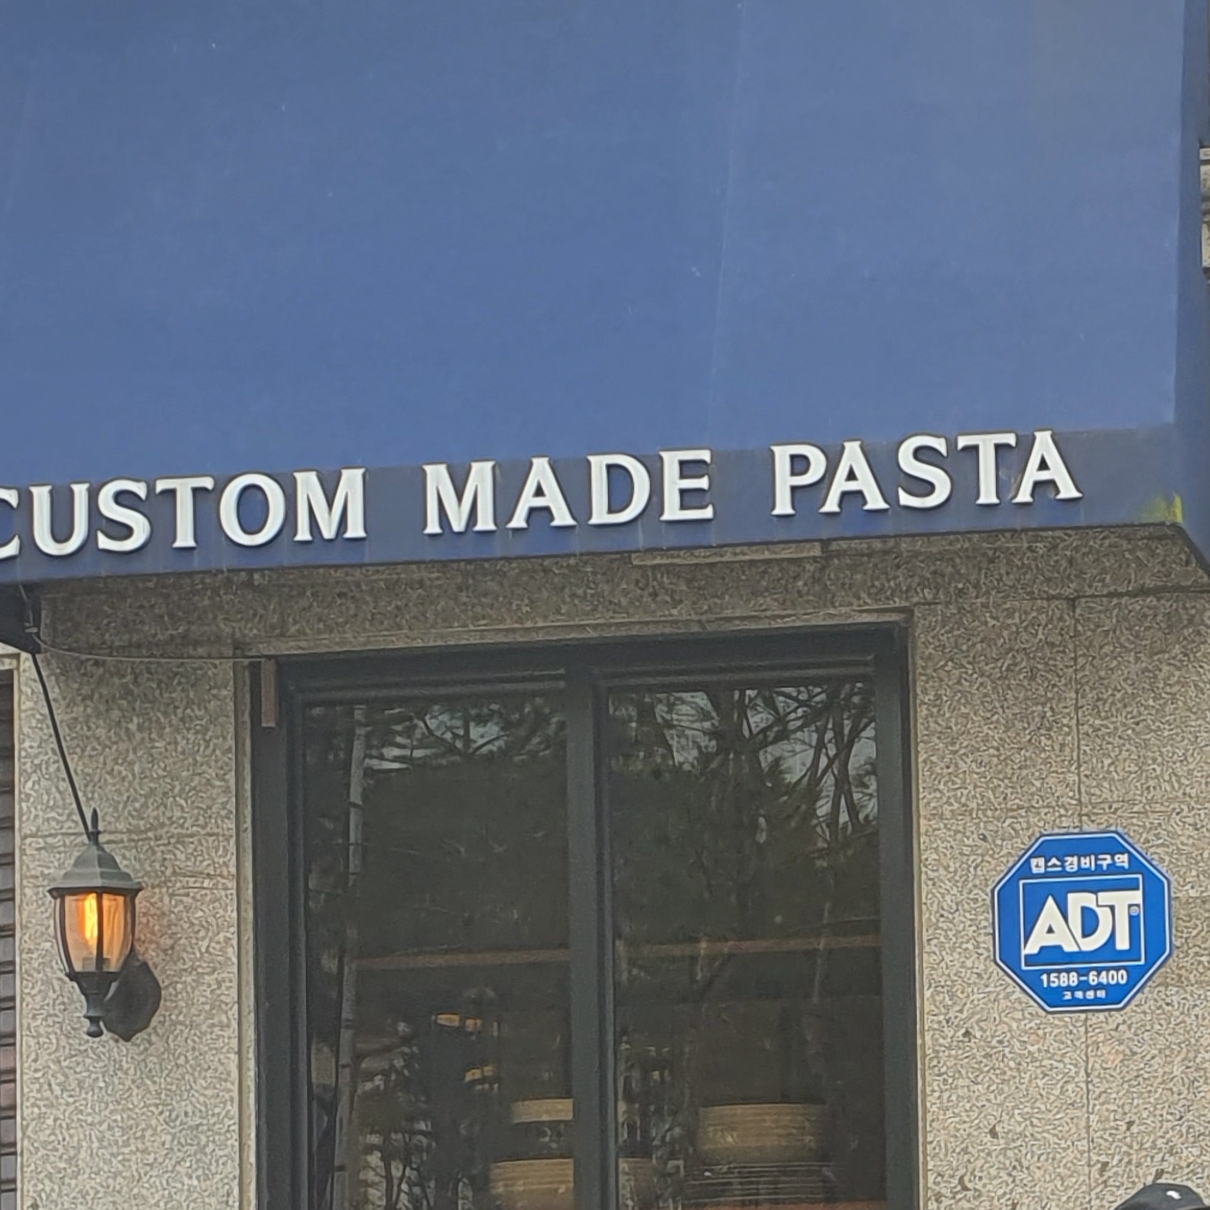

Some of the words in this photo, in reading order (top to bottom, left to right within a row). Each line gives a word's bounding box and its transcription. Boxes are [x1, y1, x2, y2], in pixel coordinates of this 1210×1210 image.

[423, 448, 715, 535] MADE
[769, 429, 1084, 517] PASTA
[1023, 889, 1142, 955] ADT
[1040, 969, 1128, 988] 1588-6400
